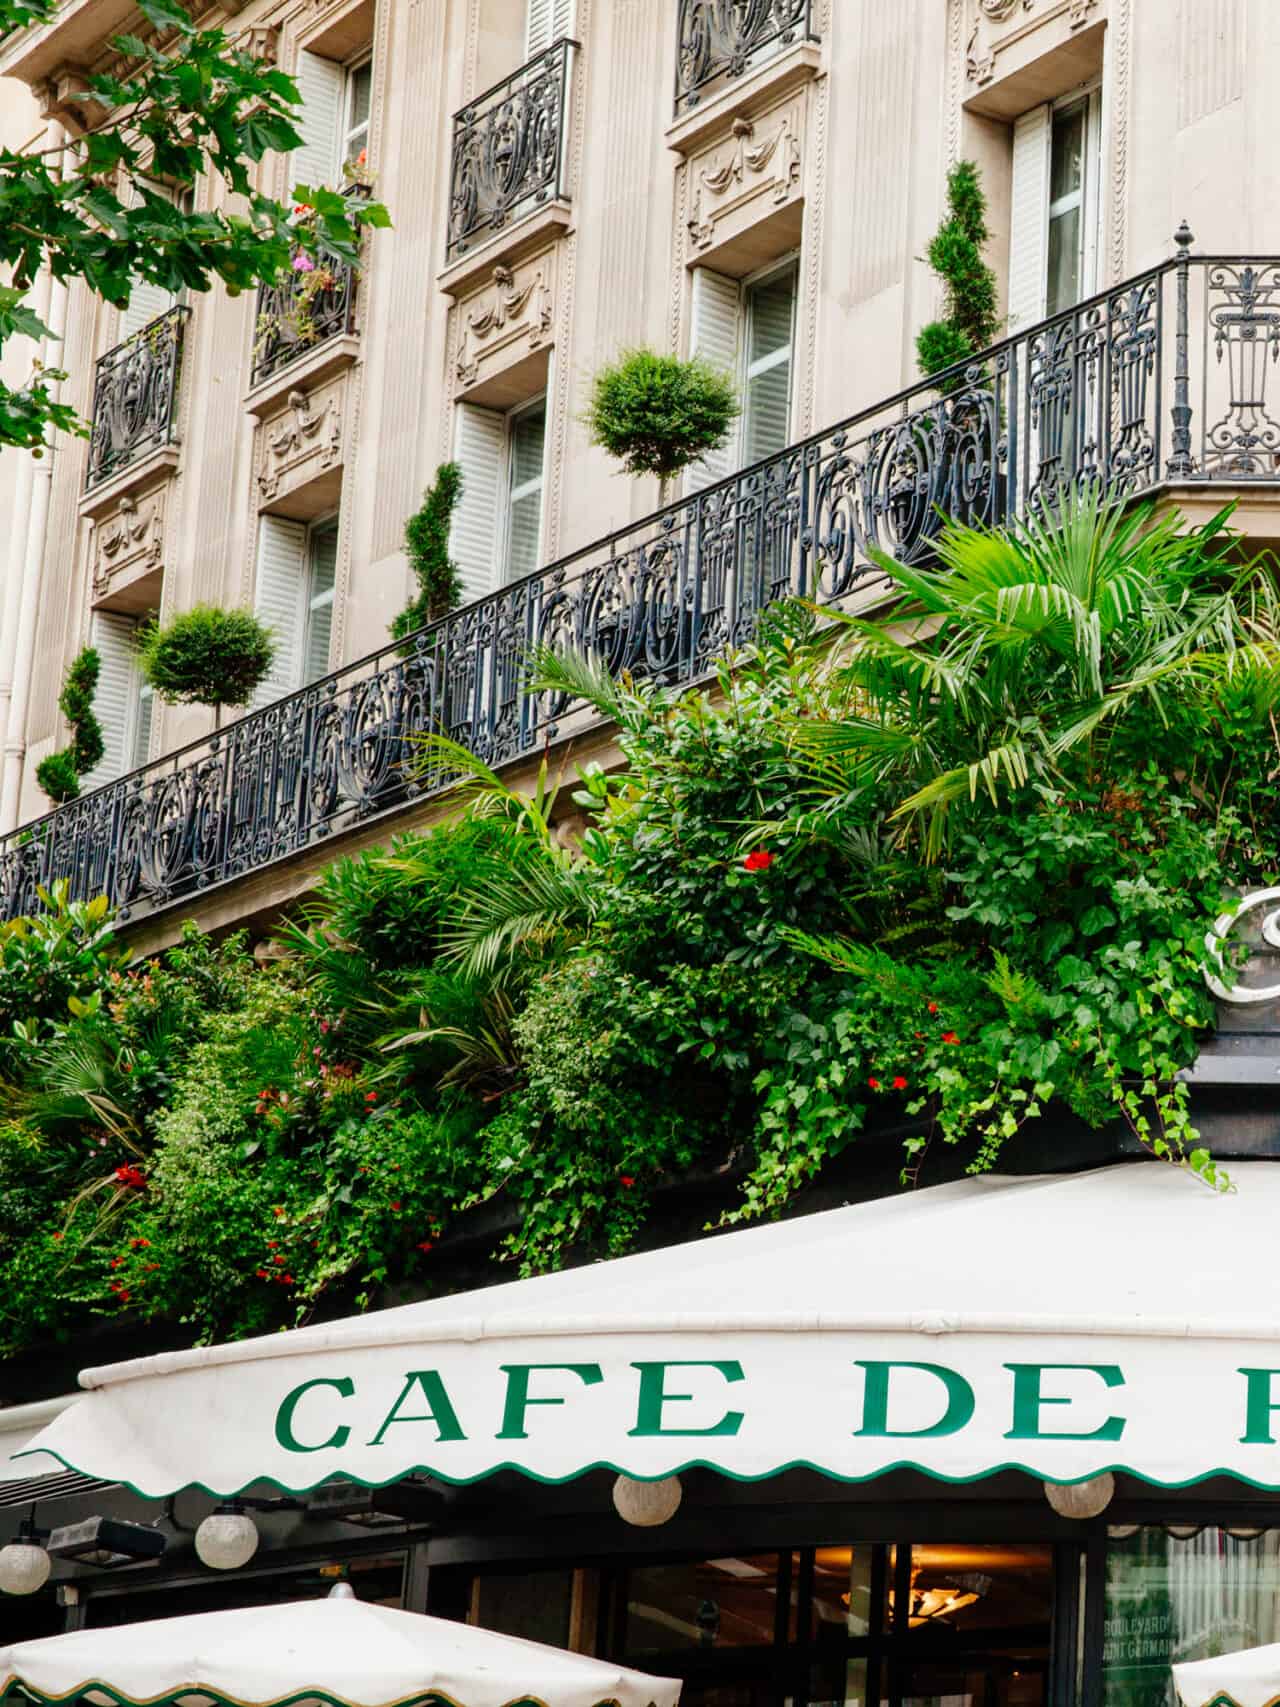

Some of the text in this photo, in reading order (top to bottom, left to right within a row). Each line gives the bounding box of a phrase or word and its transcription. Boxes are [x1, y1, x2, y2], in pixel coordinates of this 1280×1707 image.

[275, 1359, 745, 1453] CAFE
[853, 1360, 1127, 1442] DE
[1102, 1641, 1126, 1661] AINT
